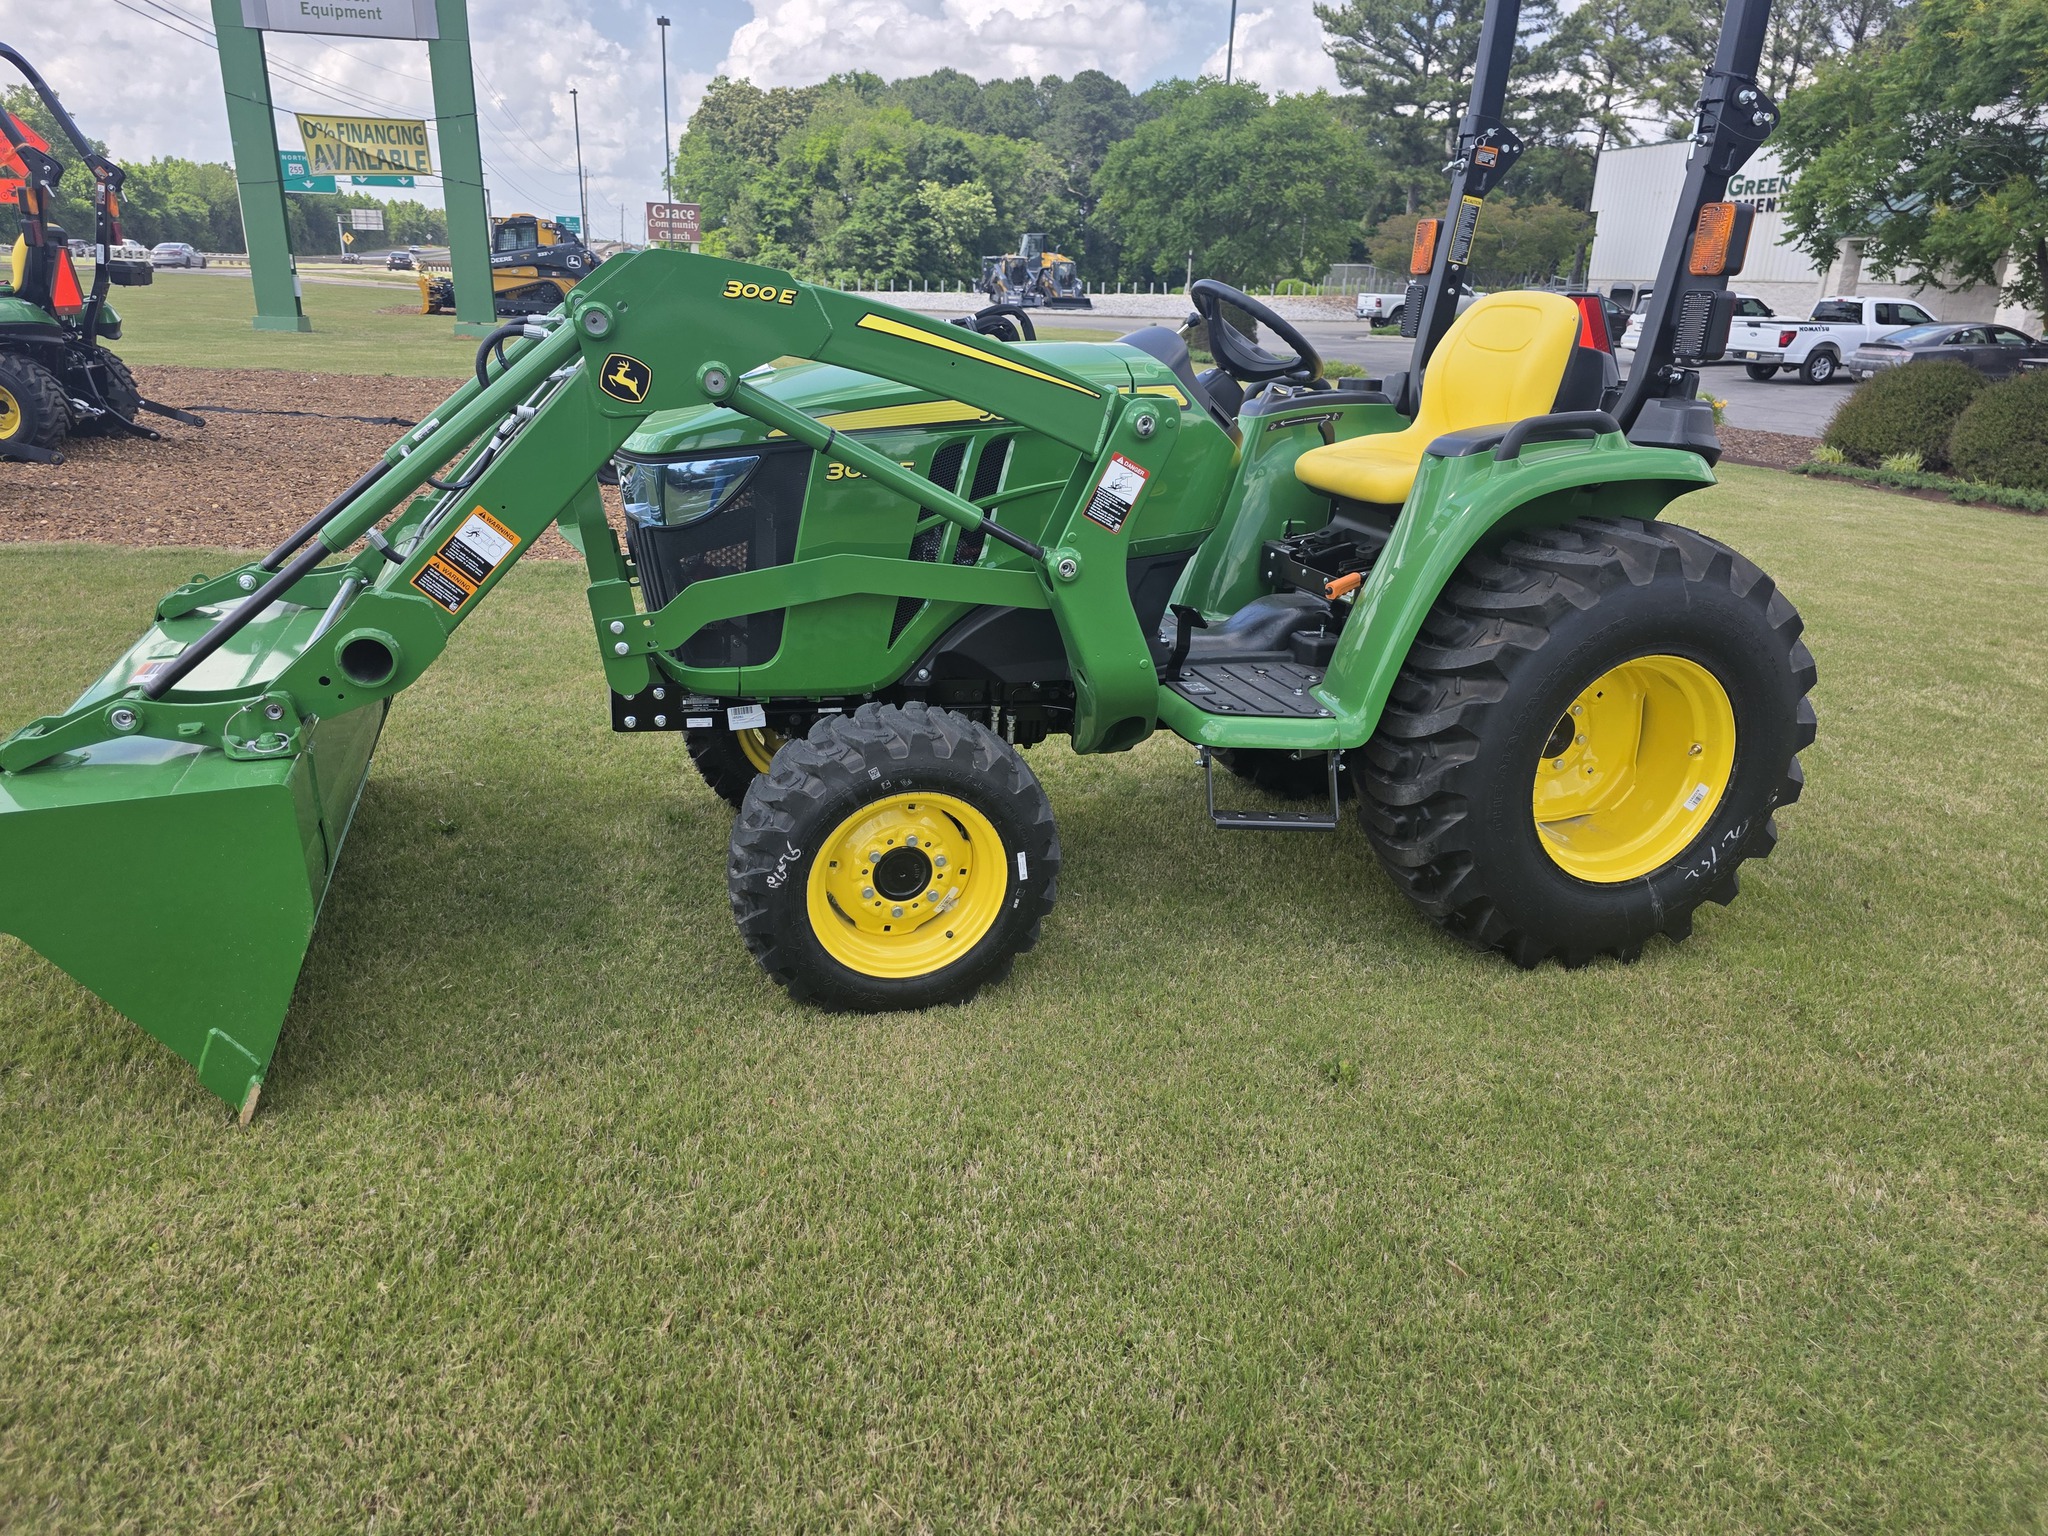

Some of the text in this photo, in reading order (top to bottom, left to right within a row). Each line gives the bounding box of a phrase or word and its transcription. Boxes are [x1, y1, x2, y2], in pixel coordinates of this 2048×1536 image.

[300, 1, 383, 20] Equipment
[302, 120, 424, 146] 0% FINANCING
[314, 143, 428, 172] AVAILABLE
[289, 166, 303, 174] 255
[1728, 174, 1791, 197] GREEN
[652, 204, 695, 220] Grace
[1123, 460, 1145, 477] DANGER
[486, 516, 515, 541] WARNING
[442, 566, 471, 591] WARNING
